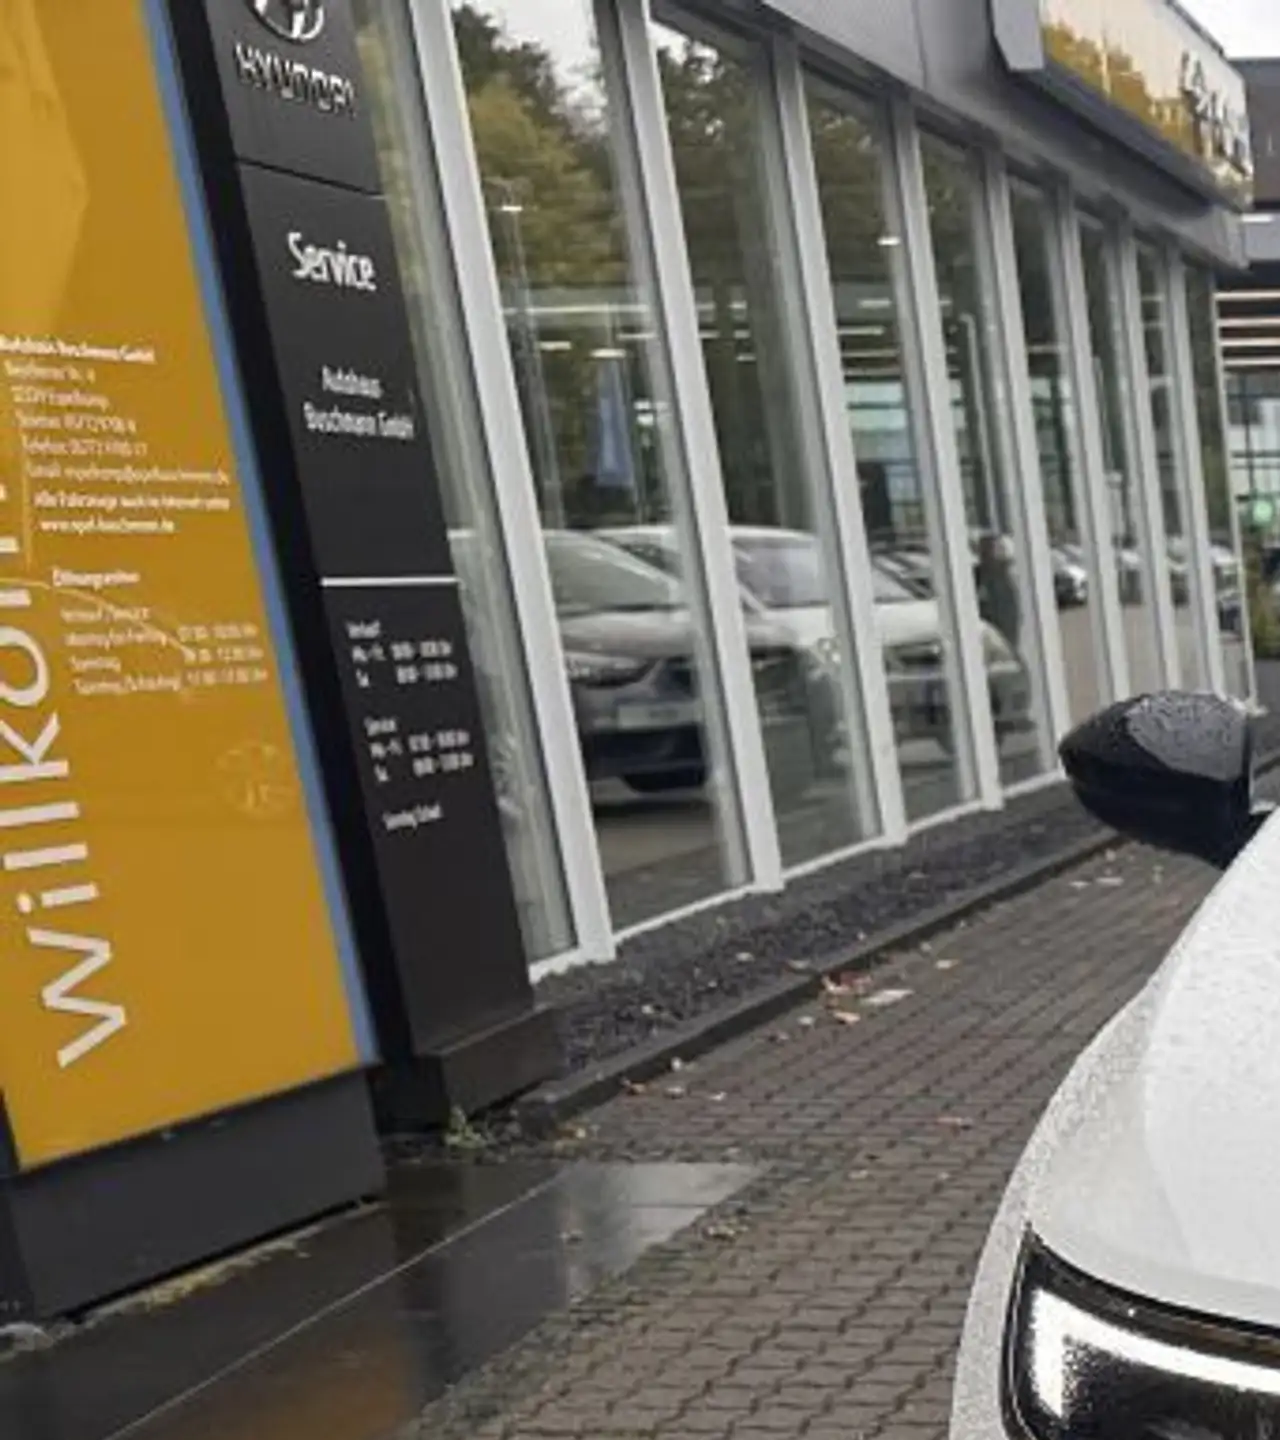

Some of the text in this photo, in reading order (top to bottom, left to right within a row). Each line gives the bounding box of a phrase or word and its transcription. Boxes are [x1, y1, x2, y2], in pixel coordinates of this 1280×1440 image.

[287, 231, 378, 291] Service
[322, 364, 384, 399] Autohaus
[303, 401, 415, 439] Buschmann GmbH
